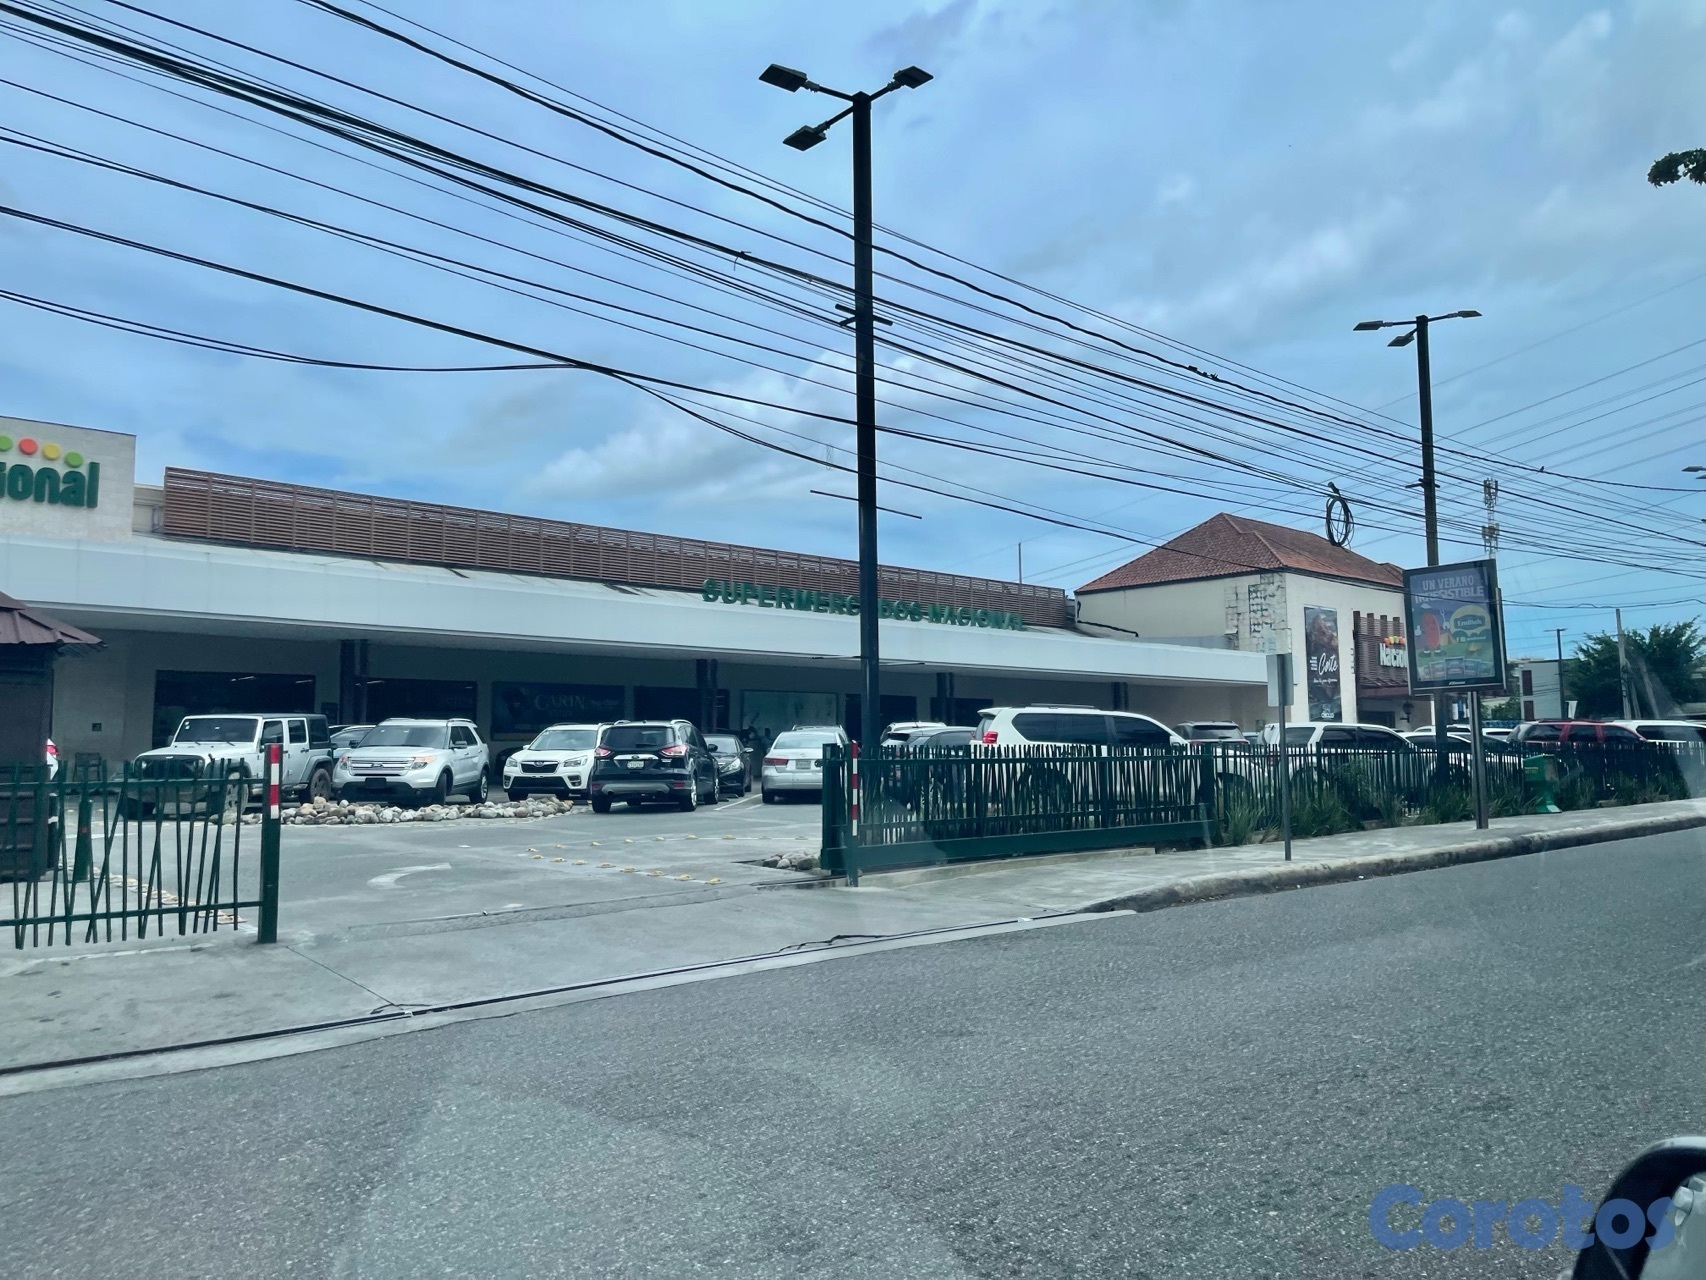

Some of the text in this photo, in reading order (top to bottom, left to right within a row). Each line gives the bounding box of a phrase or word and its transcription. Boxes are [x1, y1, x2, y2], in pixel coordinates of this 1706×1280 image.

[1422, 575, 1474, 591] UN VERANO
[702, 578, 1026, 631] SUPERMERCDOS NACIONAL
